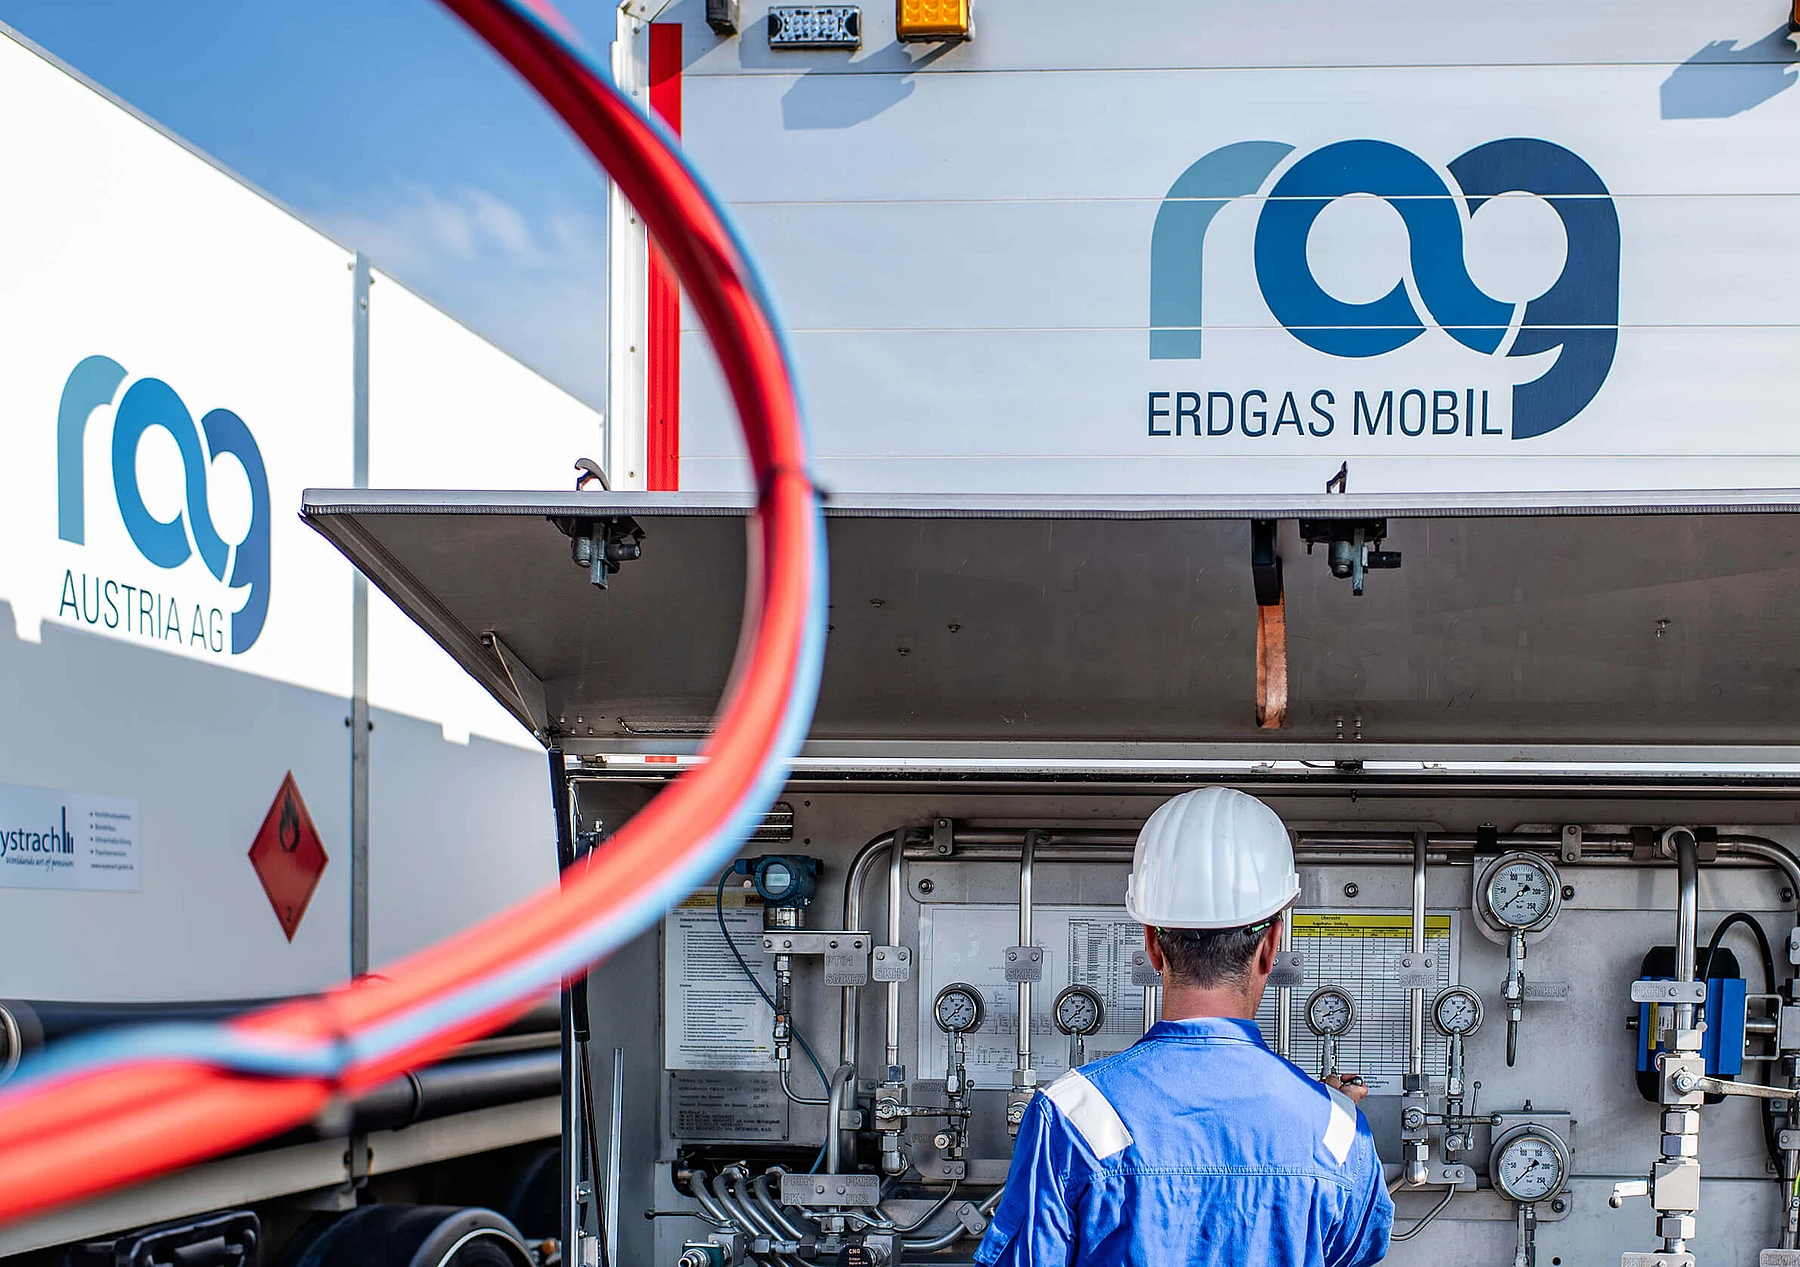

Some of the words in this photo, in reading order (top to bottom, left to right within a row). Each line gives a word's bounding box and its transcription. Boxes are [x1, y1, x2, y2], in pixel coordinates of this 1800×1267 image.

[1149, 137, 1621, 440] rag
[1148, 388, 1335, 438] ERDGAS
[1353, 388, 1504, 438] MOBIL
[57, 355, 271, 655] rag
[59, 569, 182, 645] AUSTRIA
[190, 603, 223, 653] AG
[1525, 874, 1534, 882] 150
[1500, 886, 1507, 894] 50
[875, 967, 908, 980] SKH1
[1006, 967, 1041, 980] SKH2
[1133, 971, 1162, 984] SKH
[1400, 974, 1436, 987] SKH5
[1536, 1176, 1546, 1184] 250
